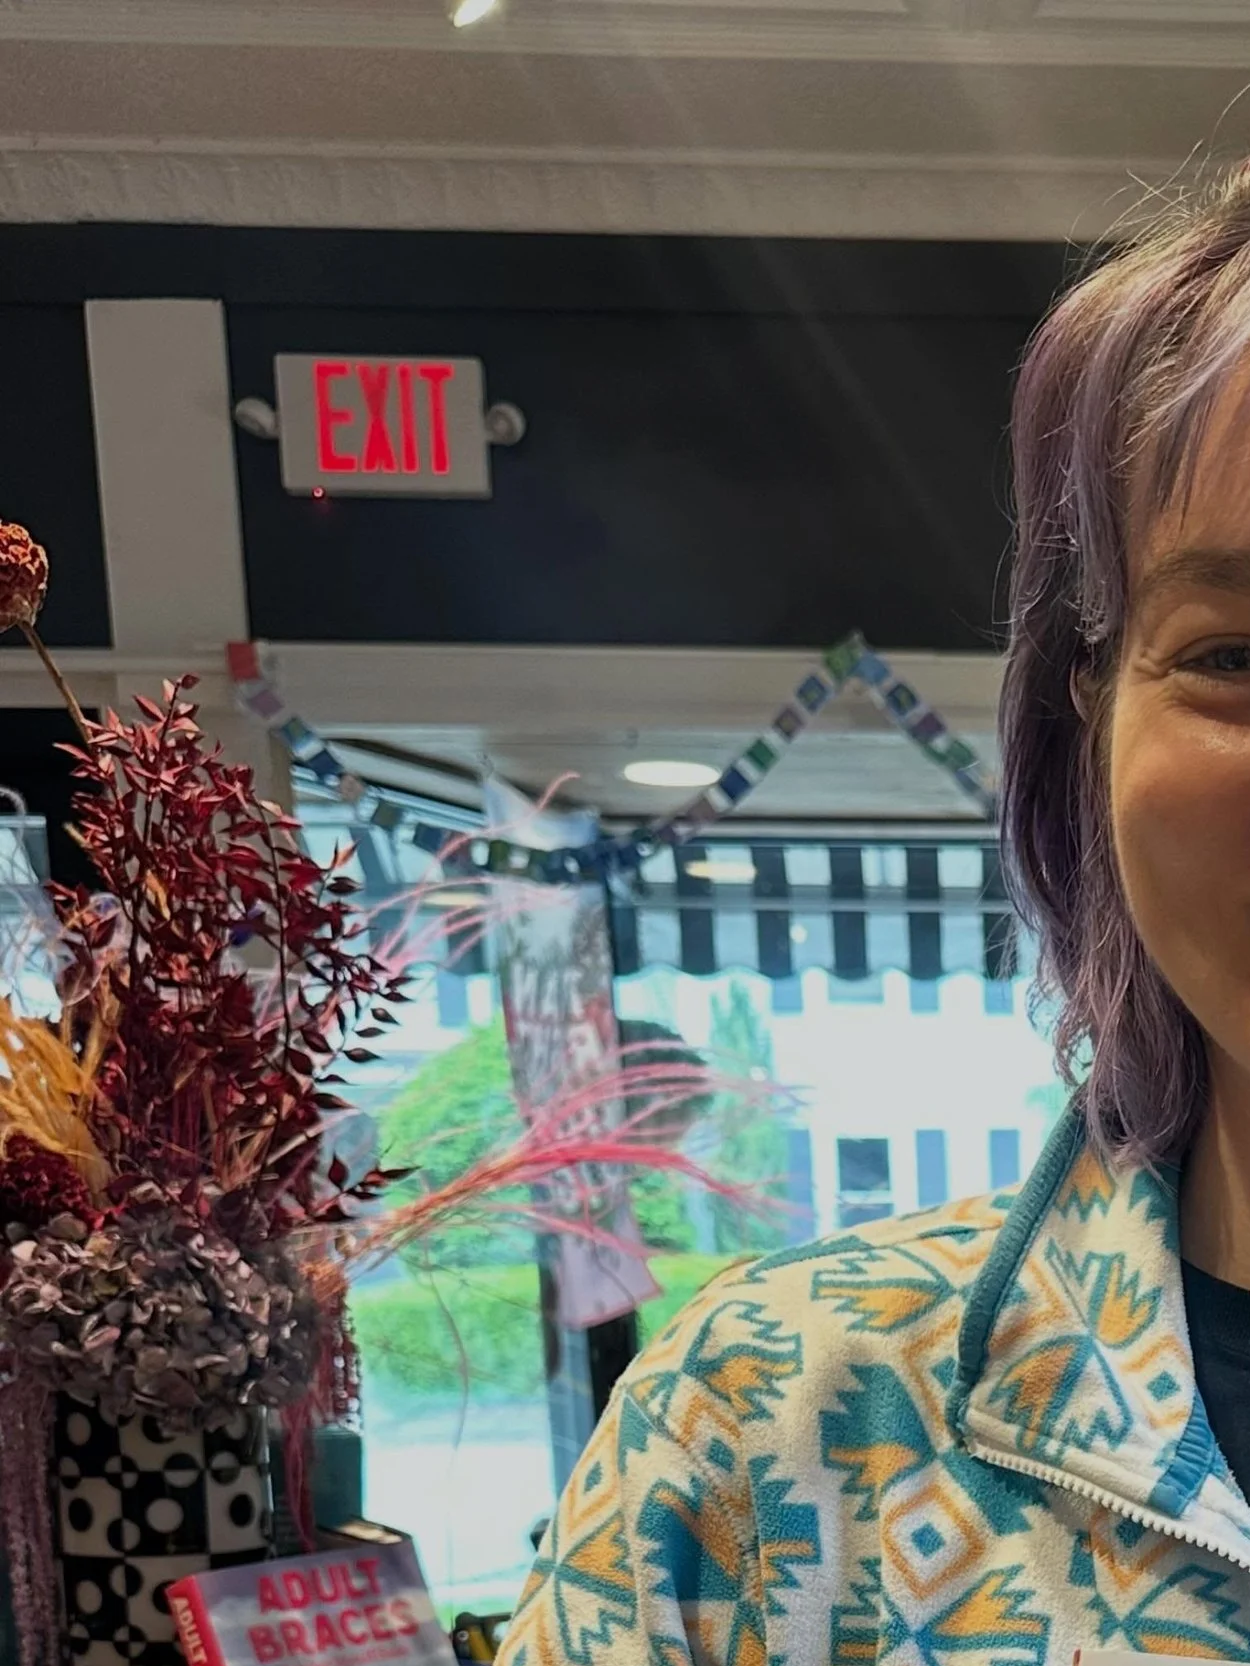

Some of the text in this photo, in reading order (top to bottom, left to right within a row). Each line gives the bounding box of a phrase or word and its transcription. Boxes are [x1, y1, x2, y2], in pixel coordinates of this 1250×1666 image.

[313, 361, 453, 475] EXIT
[258, 1558, 382, 1616] ADULT
[248, 1600, 419, 1666] BRACES
